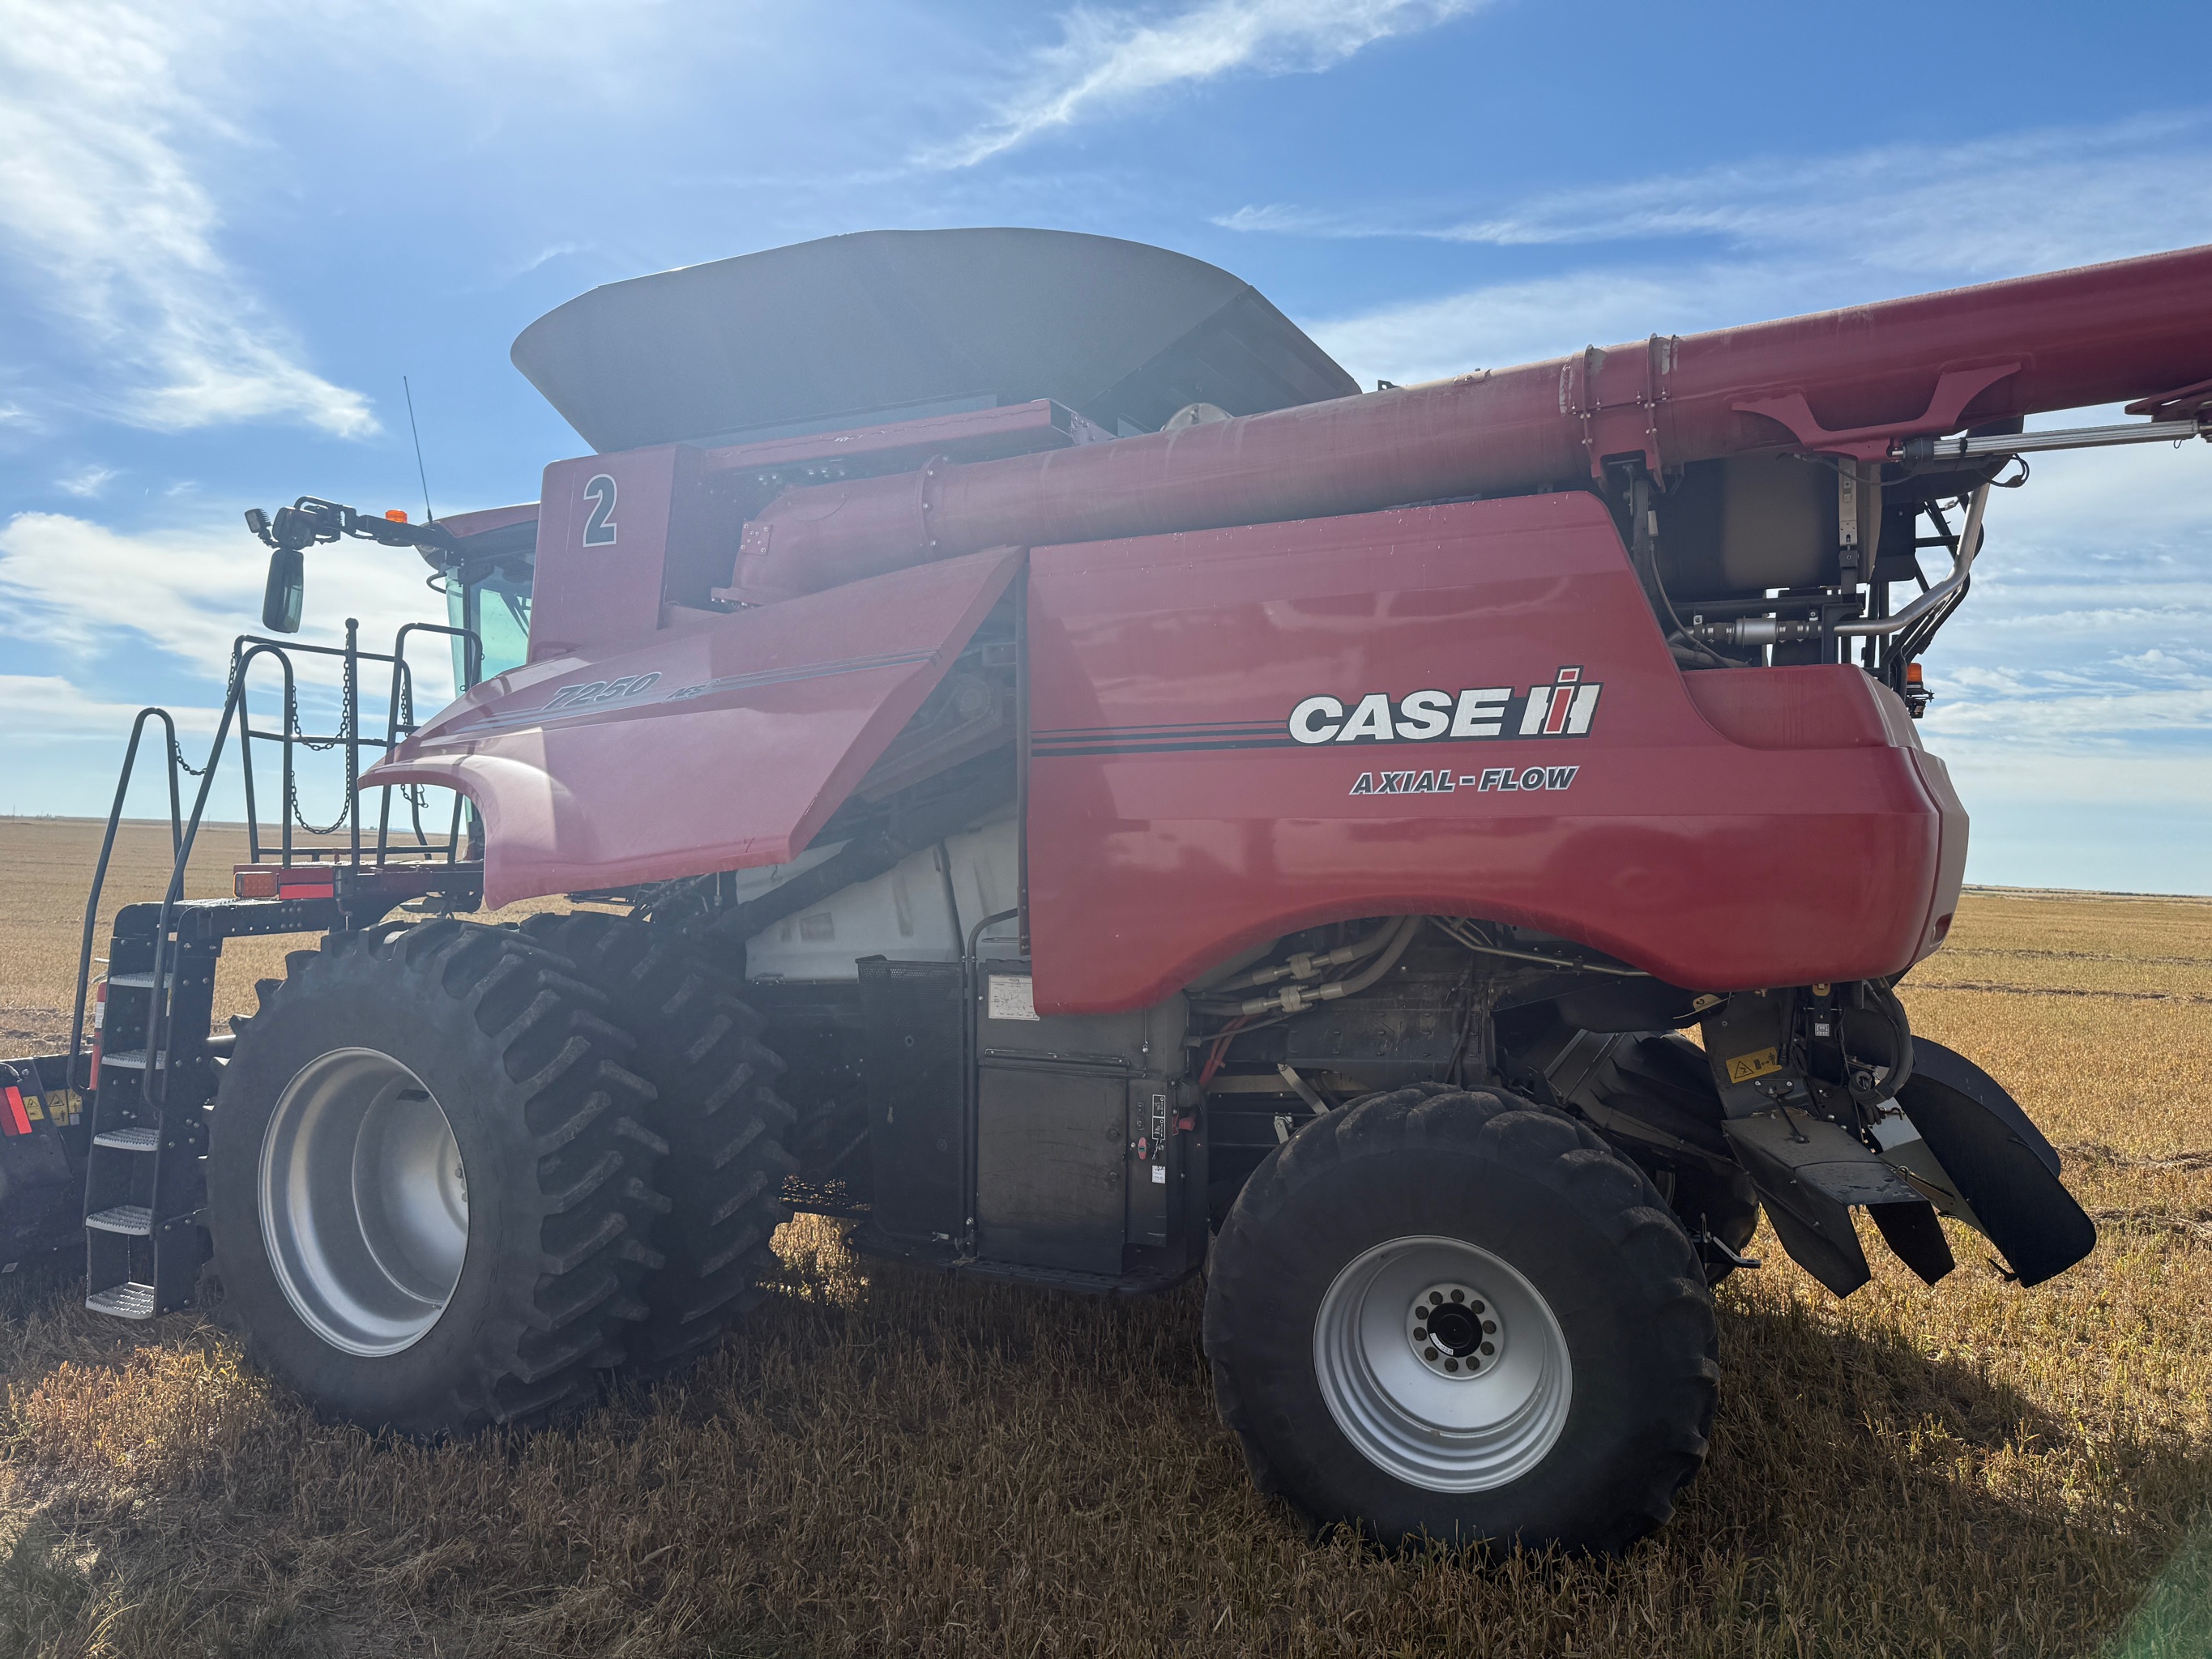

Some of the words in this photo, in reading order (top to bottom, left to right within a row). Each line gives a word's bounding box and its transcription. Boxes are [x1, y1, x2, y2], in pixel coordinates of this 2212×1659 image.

[583, 473, 617, 548] 2
[540, 672, 662, 711] 7250
[1288, 688, 1512, 744] CASE
[1348, 765, 1582, 796] AXIAL-FLOW
